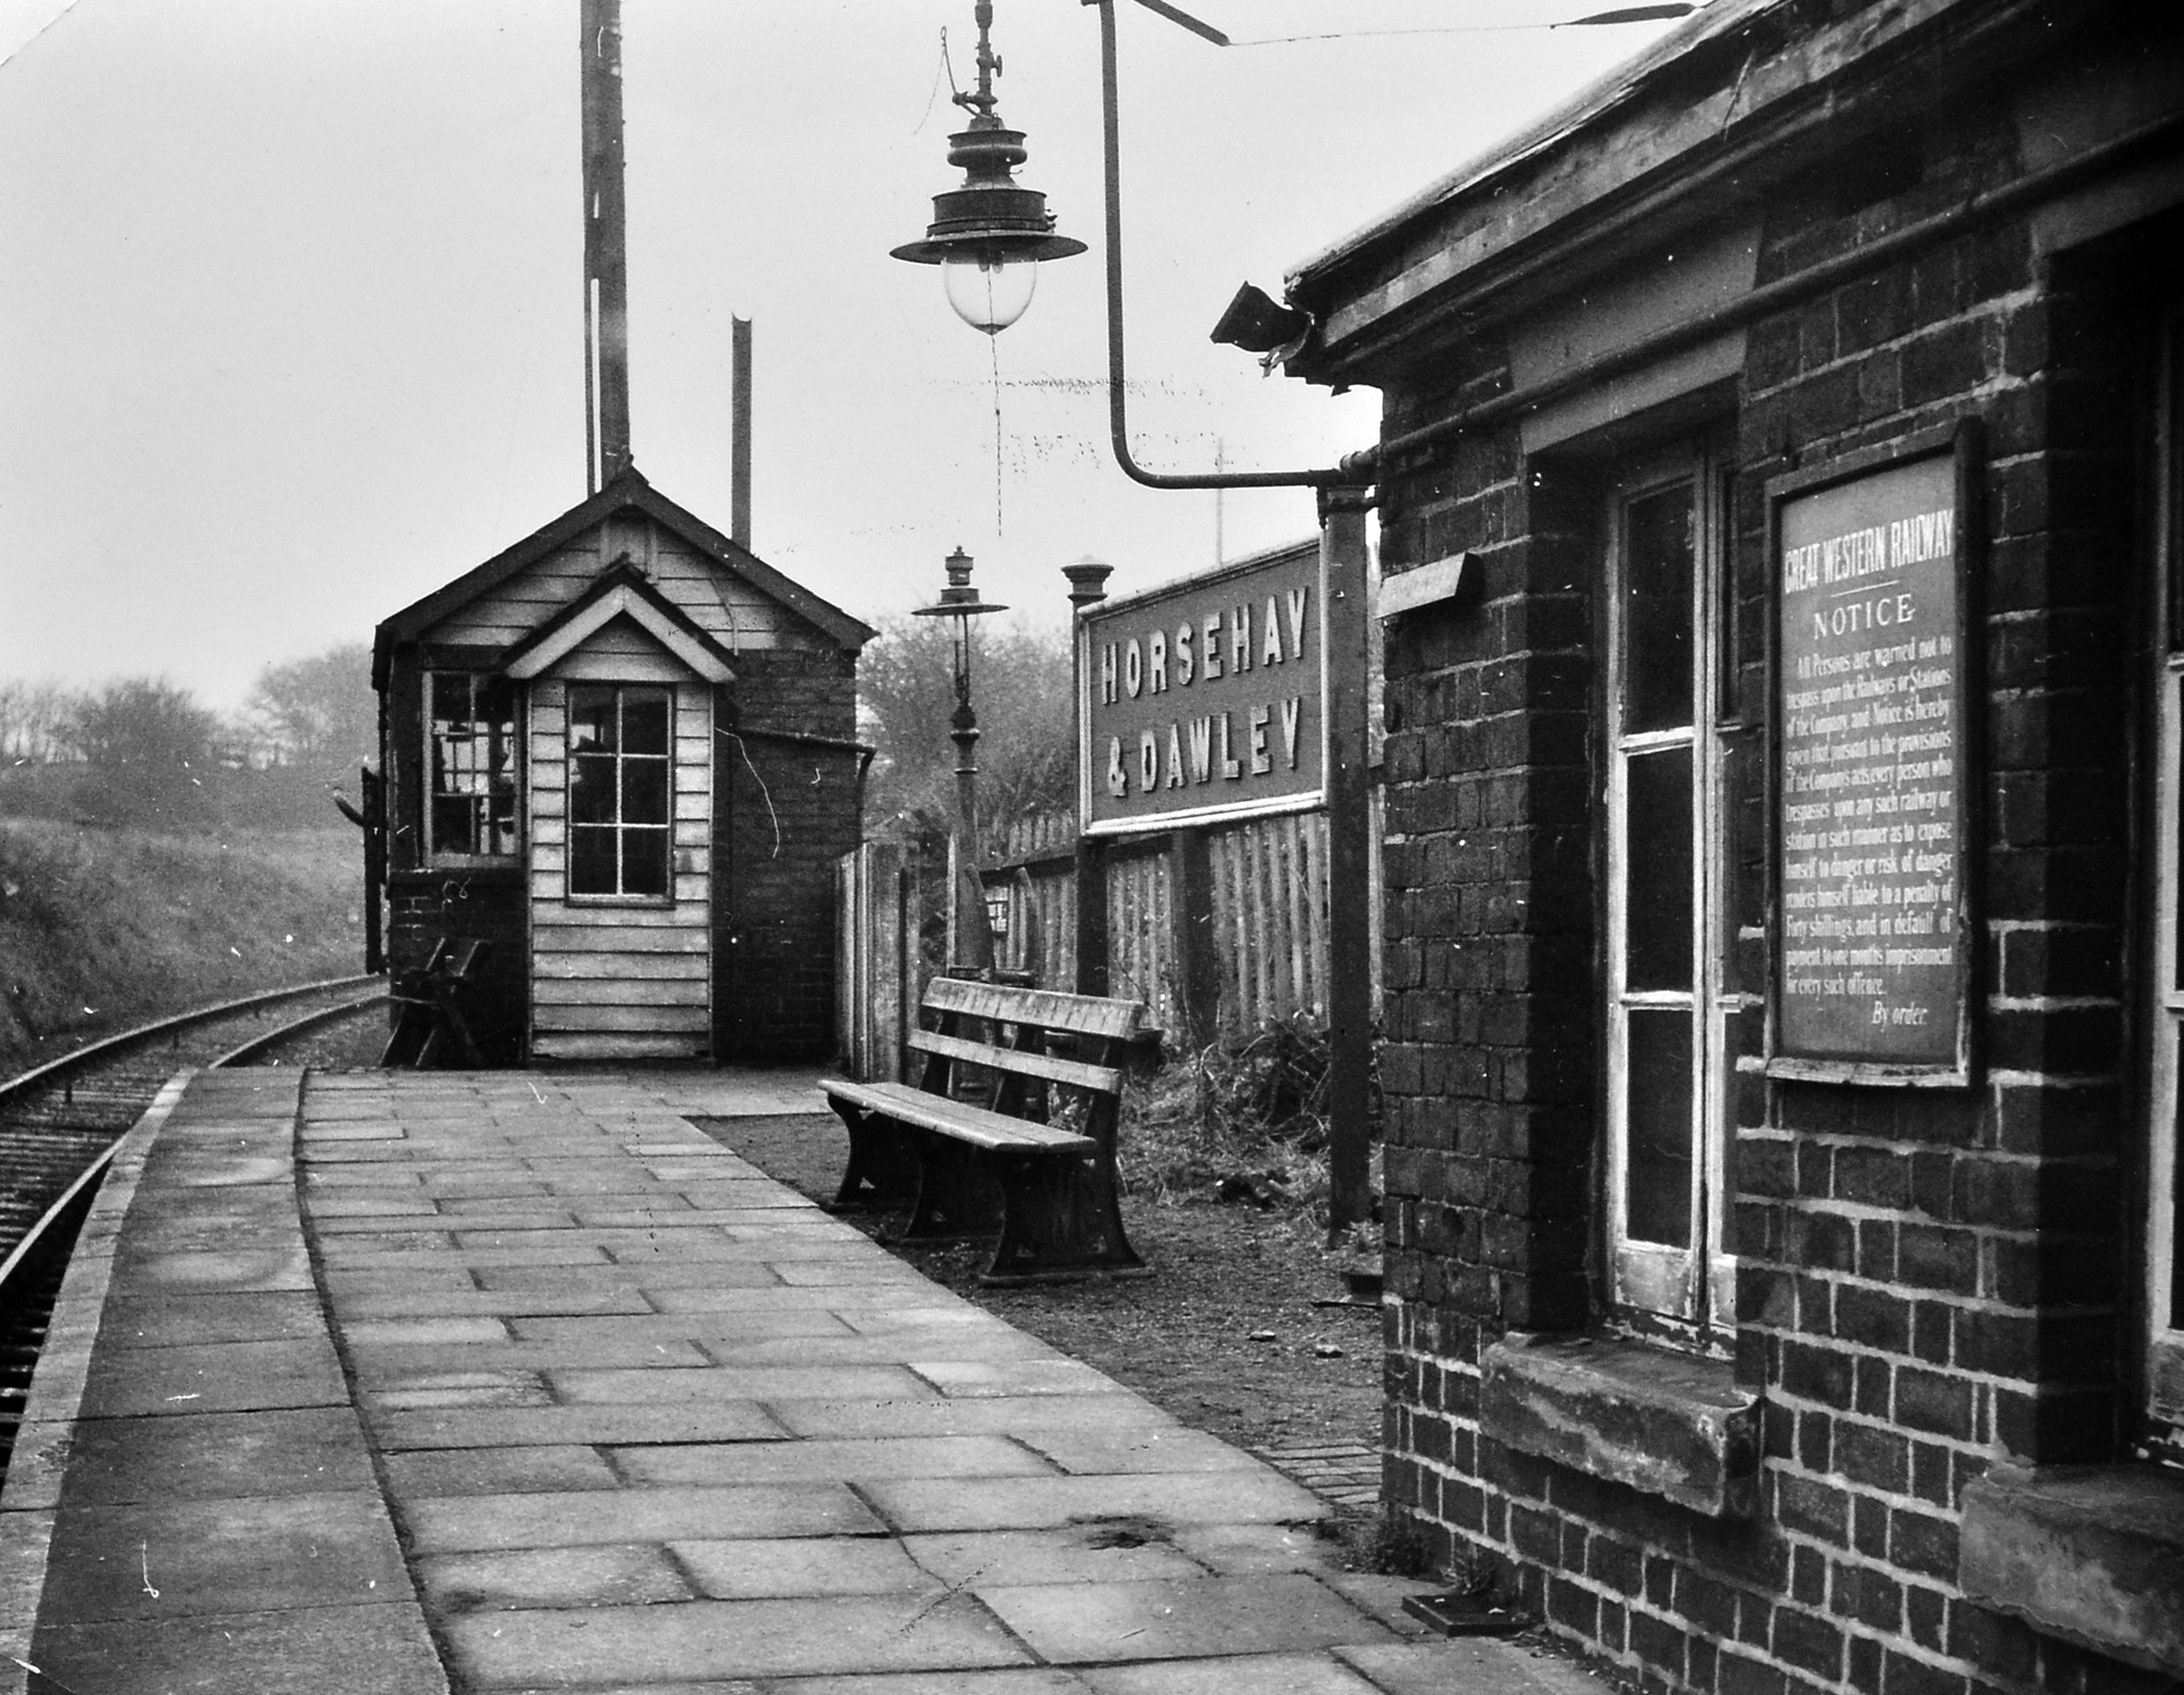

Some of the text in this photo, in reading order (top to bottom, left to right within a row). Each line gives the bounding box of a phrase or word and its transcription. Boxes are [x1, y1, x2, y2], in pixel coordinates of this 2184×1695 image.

[1784, 509, 1954, 594] GREAT WESTERN RAILWAY
[1814, 593, 1915, 639] NOTICE
[1101, 586, 1309, 706] HORSEHAY
[1798, 636, 1952, 679] All Persons are warned not to
[1107, 697, 1300, 797] & DAWLEY
[1786, 915, 1807, 945] Forty
[1855, 912, 1877, 936] and
[1880, 913, 1891, 935] in
[1894, 910, 1934, 935] default
[1940, 908, 1954, 934] of
[1786, 973, 1798, 994] for
[1798, 978, 1822, 1001] every
[1824, 971, 1845, 995] such
[1871, 1000, 1888, 1033] By
